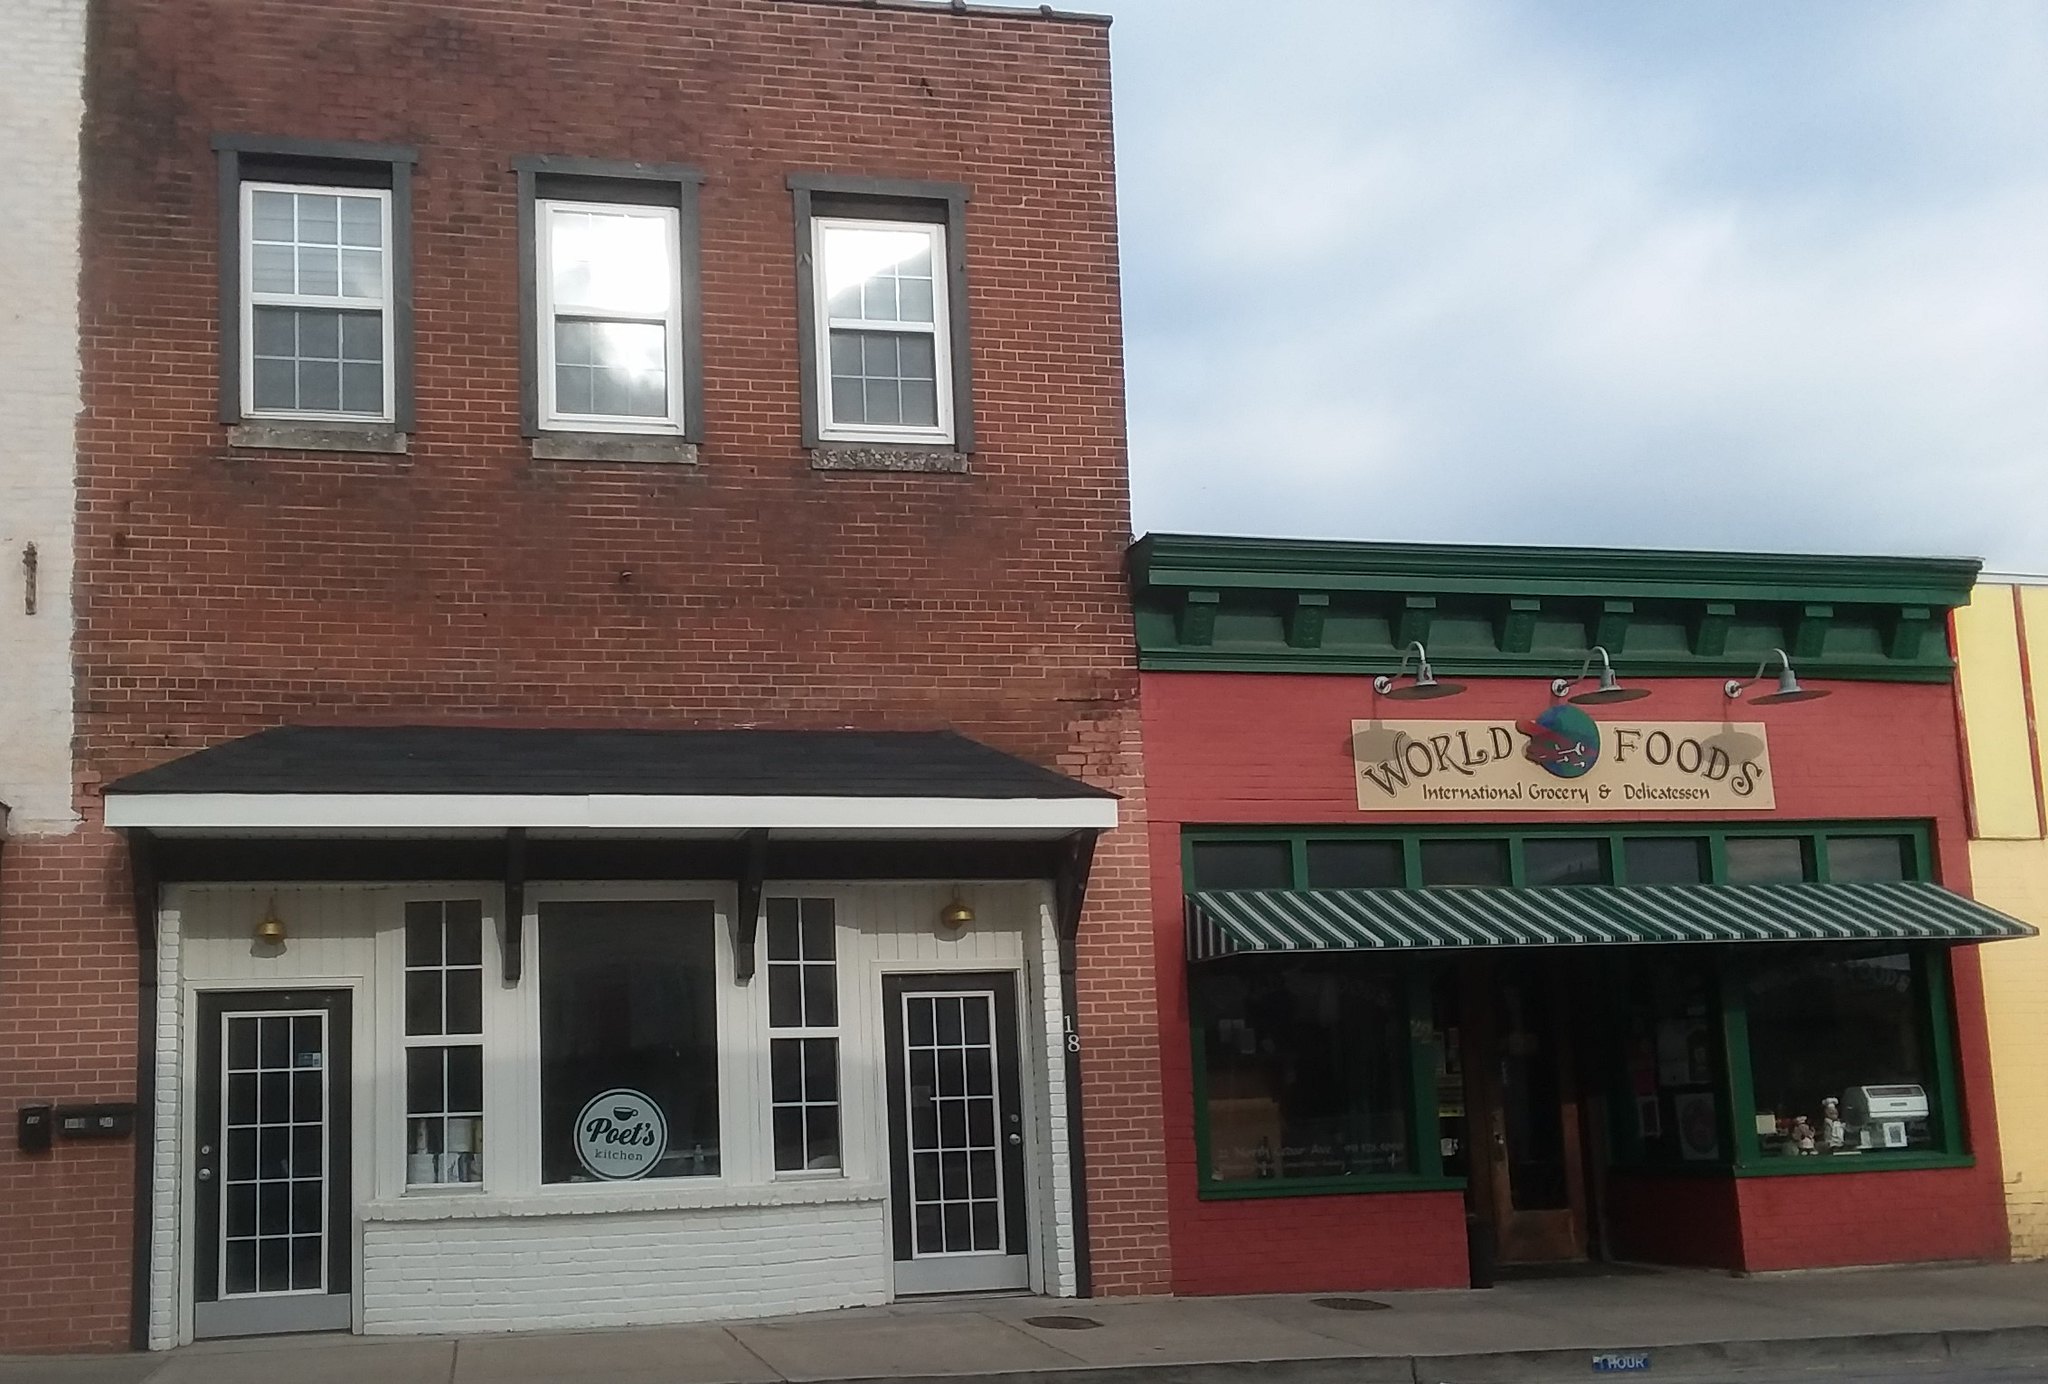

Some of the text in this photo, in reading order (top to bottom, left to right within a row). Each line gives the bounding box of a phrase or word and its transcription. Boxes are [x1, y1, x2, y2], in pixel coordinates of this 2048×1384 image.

[1362, 726, 1764, 799] WORLD FOODS
[1421, 782, 1711, 804] International Grocery & Delicatessen
[1064, 1014, 1081, 1053] 18
[586, 1117, 656, 1147] Poet's
[594, 1149, 643, 1161] kitchen
[1607, 1355, 1645, 1370] HOUR
